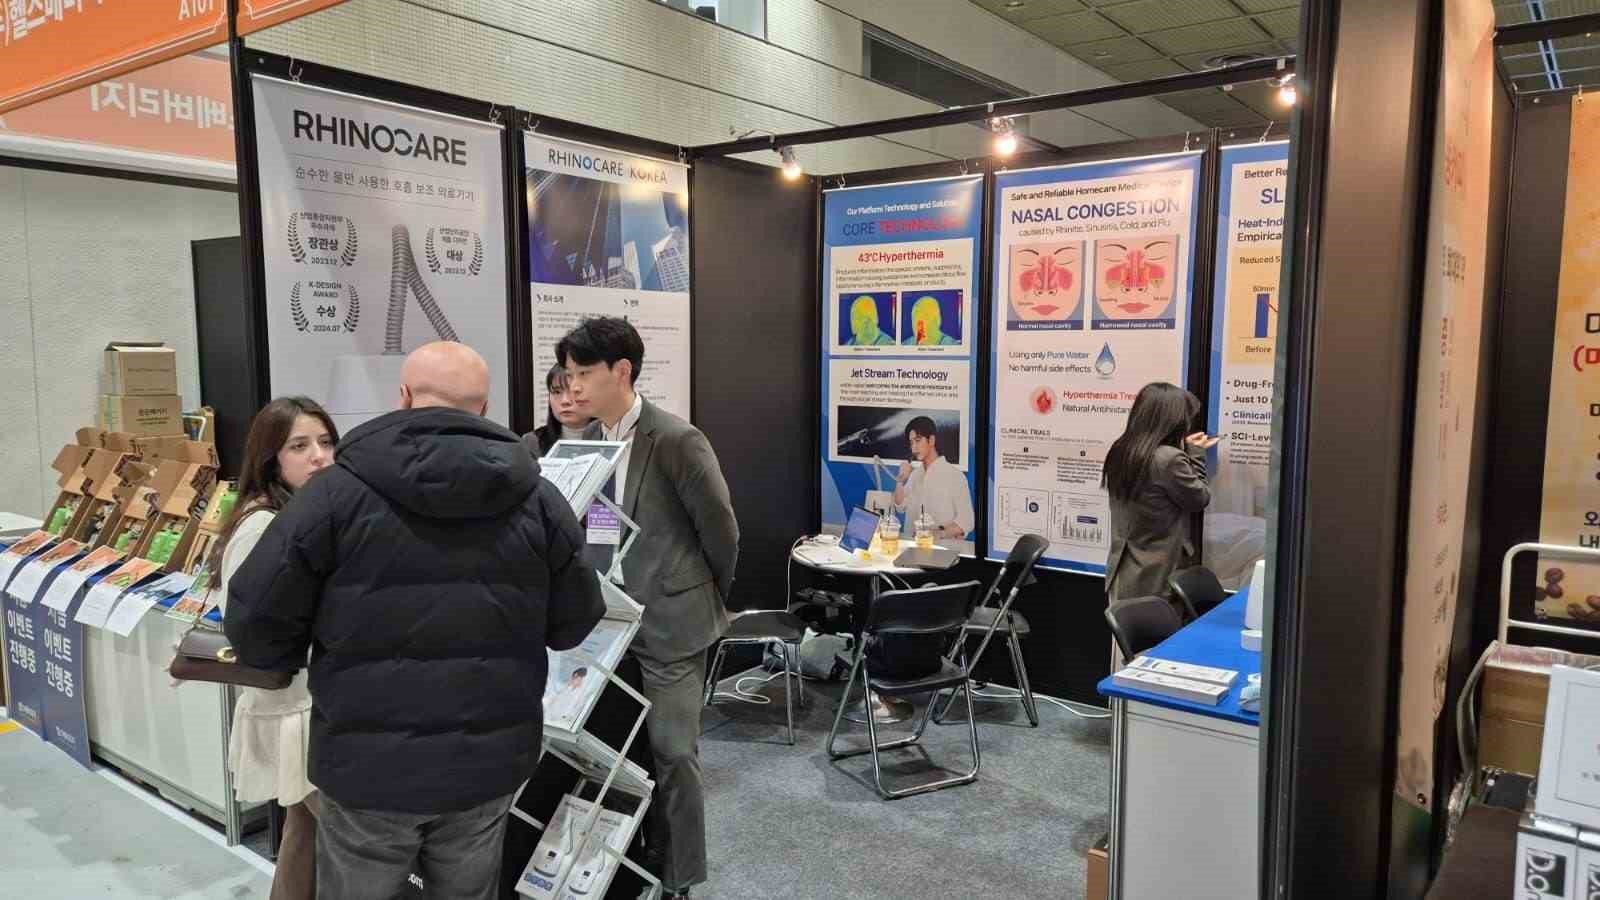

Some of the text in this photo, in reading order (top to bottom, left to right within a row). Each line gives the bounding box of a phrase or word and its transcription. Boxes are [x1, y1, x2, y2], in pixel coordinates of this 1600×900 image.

[548, 149, 668, 184] RHINOCARE KOREA
[1244, 168, 1274, 179] Better
[1010, 193, 1028, 202] Safe
[1029, 191, 1043, 200] and
[1044, 188, 1074, 198] Reliable
[1075, 185, 1116, 196] Homecare
[1260, 187, 1284, 205] SL
[1011, 198, 1181, 224] NASAL CONGESTION
[843, 221, 876, 237] CORE
[1018, 227, 1042, 237] caused
[1237, 230, 1282, 244] Empirica
[308, 237, 338, 251] 장관상
[447, 249, 463, 262] 대상
[879, 248, 944, 265] Hyperthermia
[1239, 255, 1281, 265] Reduced S
[316, 305, 337, 318] 수상
[1245, 345, 1272, 353] Before
[1009, 351, 1089, 361] Using only Pure Water
[850, 368, 948, 381] Jet Stream Technology
[1009, 364, 1092, 374] No harmful side effects
[1233, 379, 1274, 389] Drug-Fr
[1063, 391, 1137, 401] Hyperthermia Trea
[1232, 395, 1254, 404] Just
[1062, 404, 1090, 413] Natural
[1232, 410, 1271, 420] Clinicall
[1231, 432, 1271, 441] SCI-Lev
[7, 609, 35, 641] 이벤트
[44, 627, 73, 663] 이벤트
[9, 639, 37, 674] 진행중
[46, 660, 74, 698] 진행중
